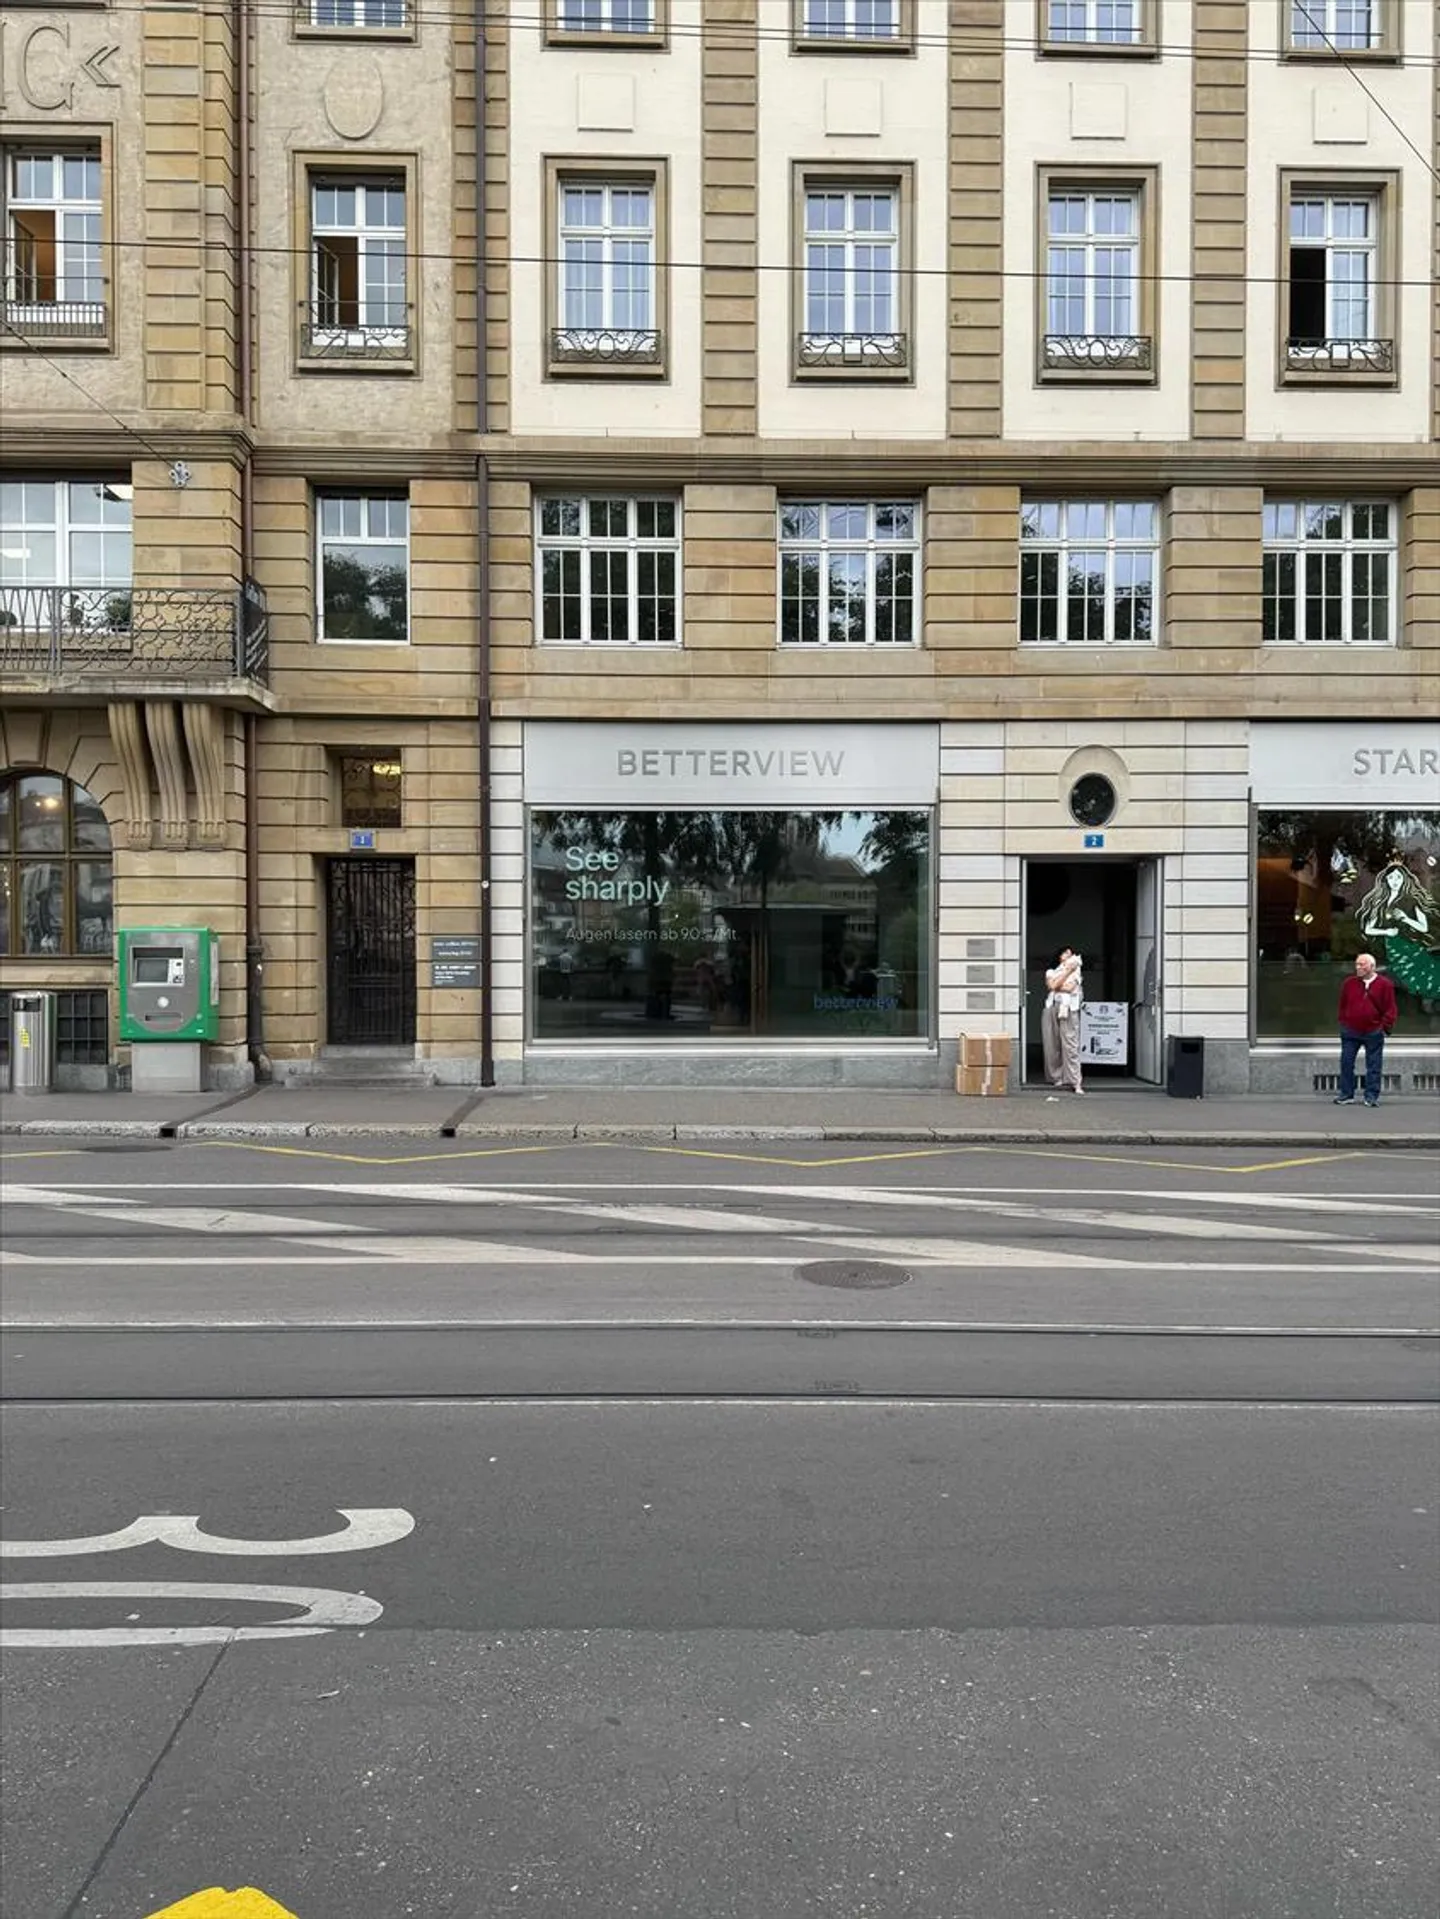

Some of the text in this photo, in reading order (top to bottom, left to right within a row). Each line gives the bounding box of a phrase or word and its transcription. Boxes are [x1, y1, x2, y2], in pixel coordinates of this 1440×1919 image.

[617, 750, 845, 776] BETTERVIEW
[1353, 748, 1440, 775] STAR
[565, 846, 619, 871] See
[565, 875, 670, 906] sharply
[660, 927, 678, 941] ab
